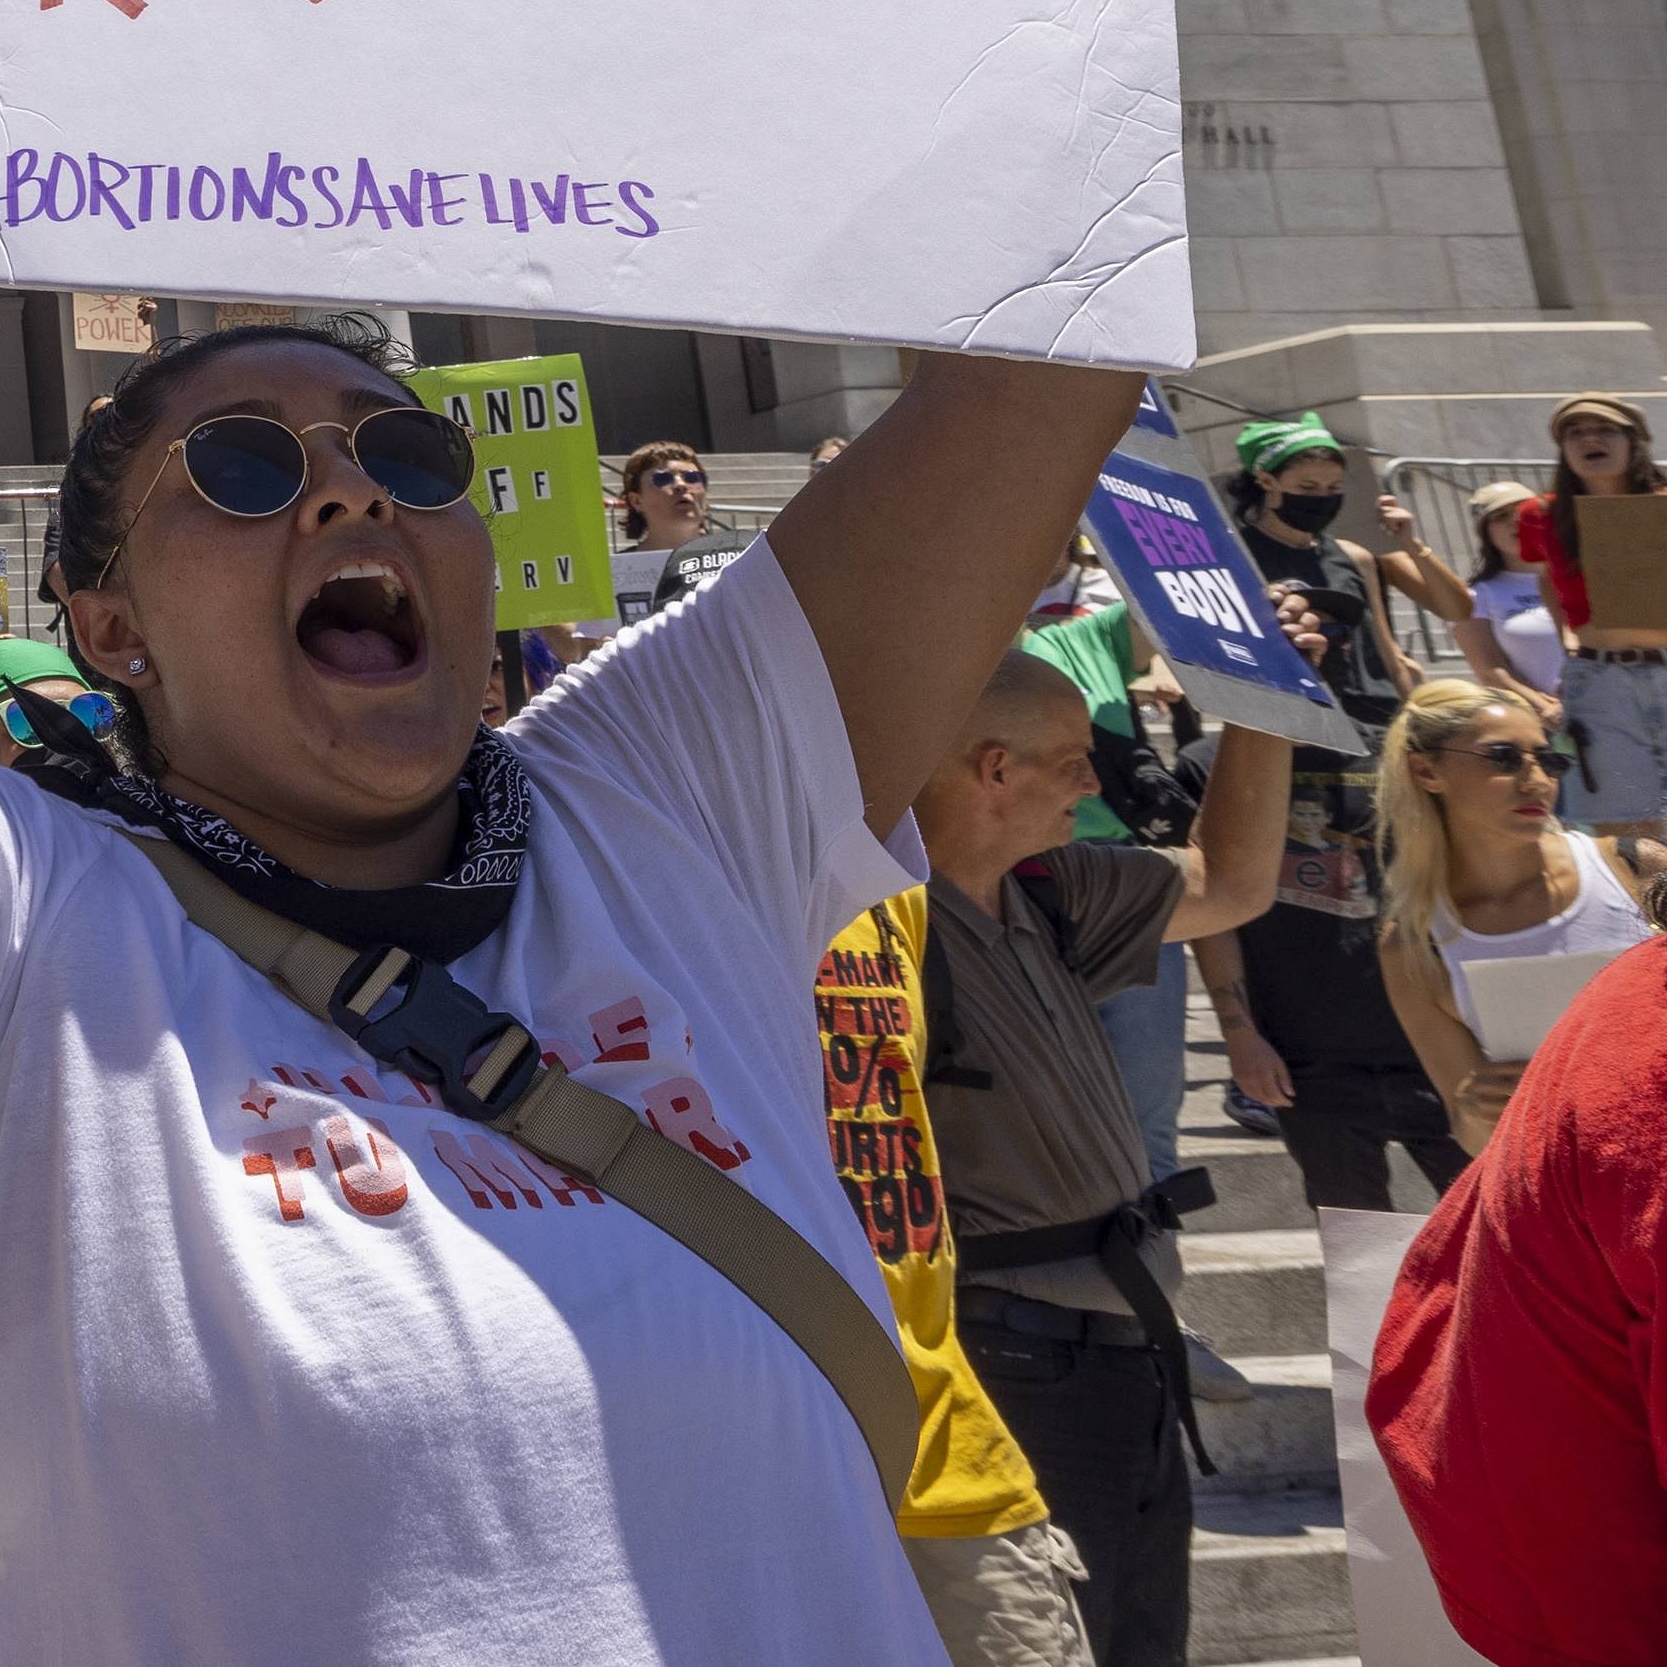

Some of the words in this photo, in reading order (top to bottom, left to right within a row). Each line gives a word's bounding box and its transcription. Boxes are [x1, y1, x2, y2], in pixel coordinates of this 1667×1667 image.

[77, 316, 152, 344] POWER
[1111, 497, 1217, 567] EVERY
[1154, 567, 1265, 640] BODY
[845, 996, 906, 1037] THE
[822, 1034, 904, 1120] 0%
